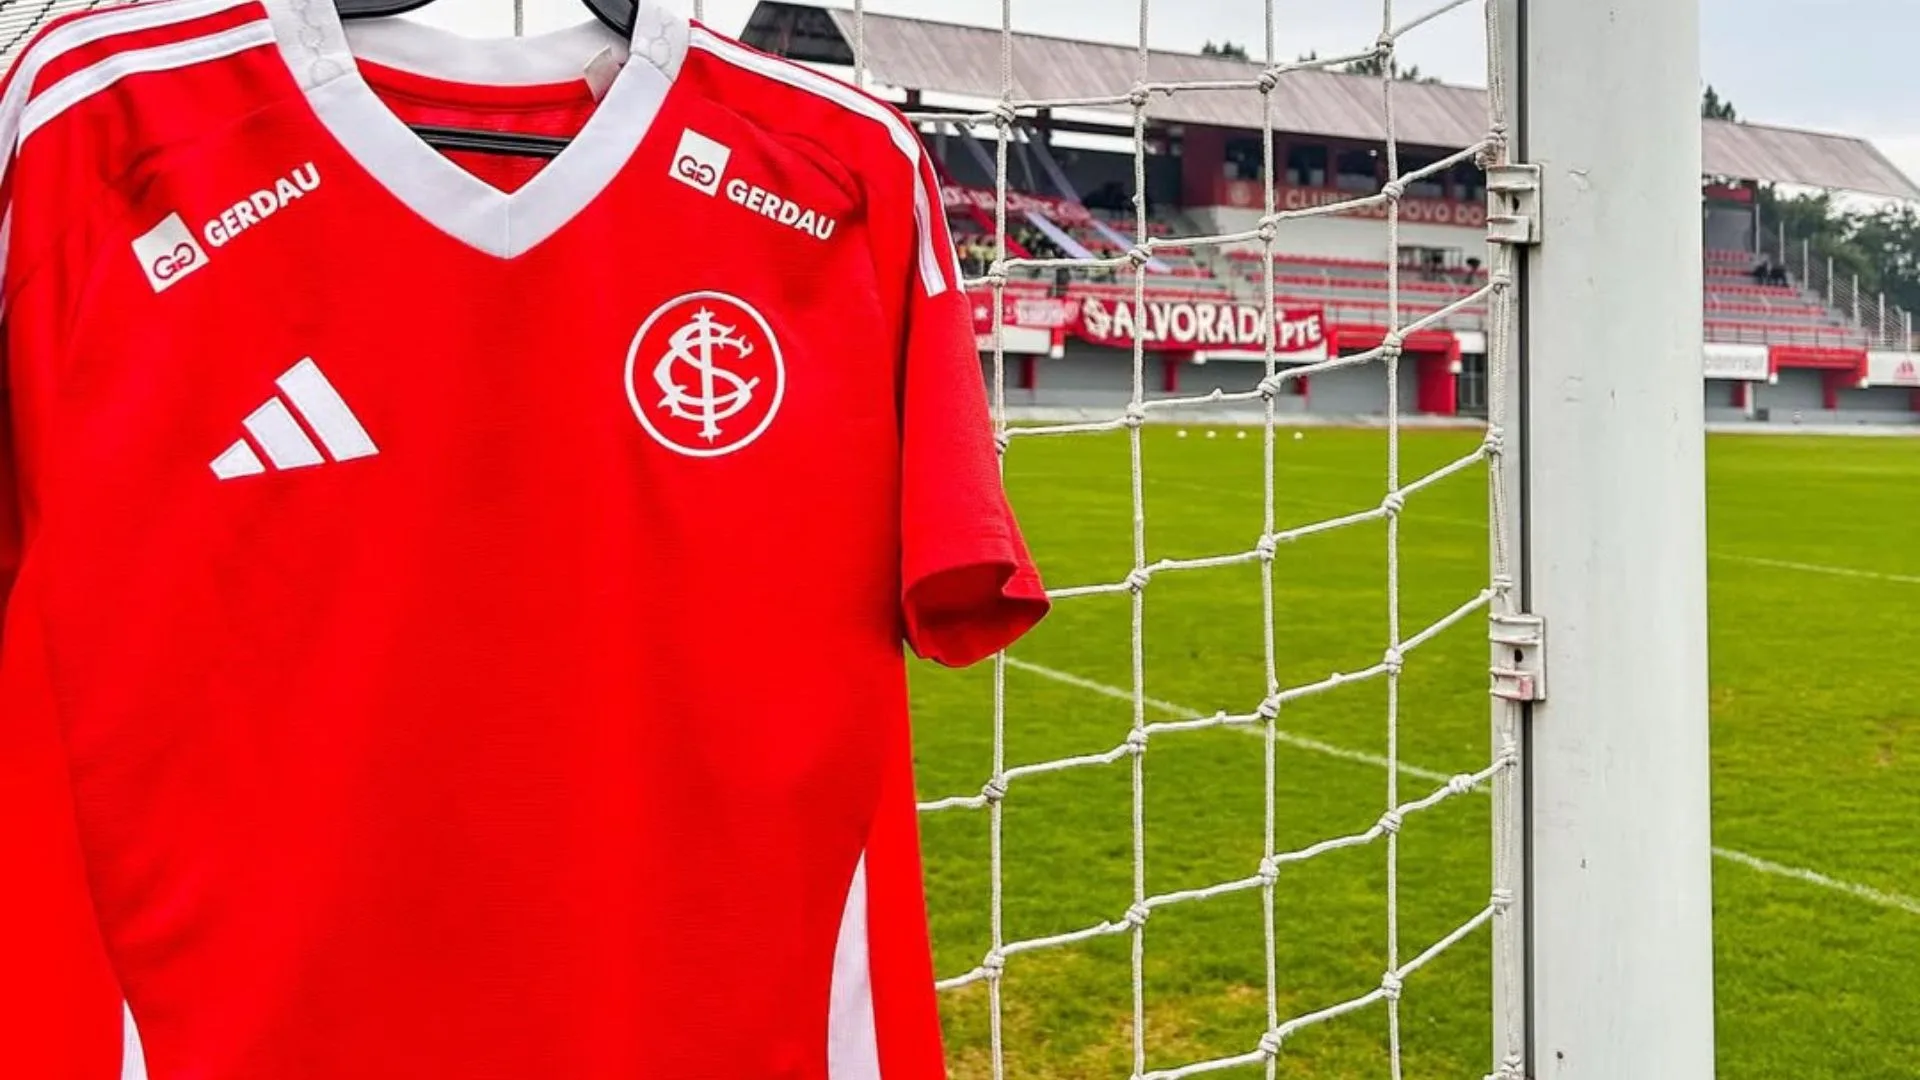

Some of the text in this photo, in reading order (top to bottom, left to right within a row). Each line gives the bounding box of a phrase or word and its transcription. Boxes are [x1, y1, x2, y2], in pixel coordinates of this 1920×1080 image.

[204, 161, 321, 248] GERDAU
[726, 178, 836, 240] GERDAU
[1398, 200, 1450, 223] OVO
[1280, 314, 1321, 348] PTE
